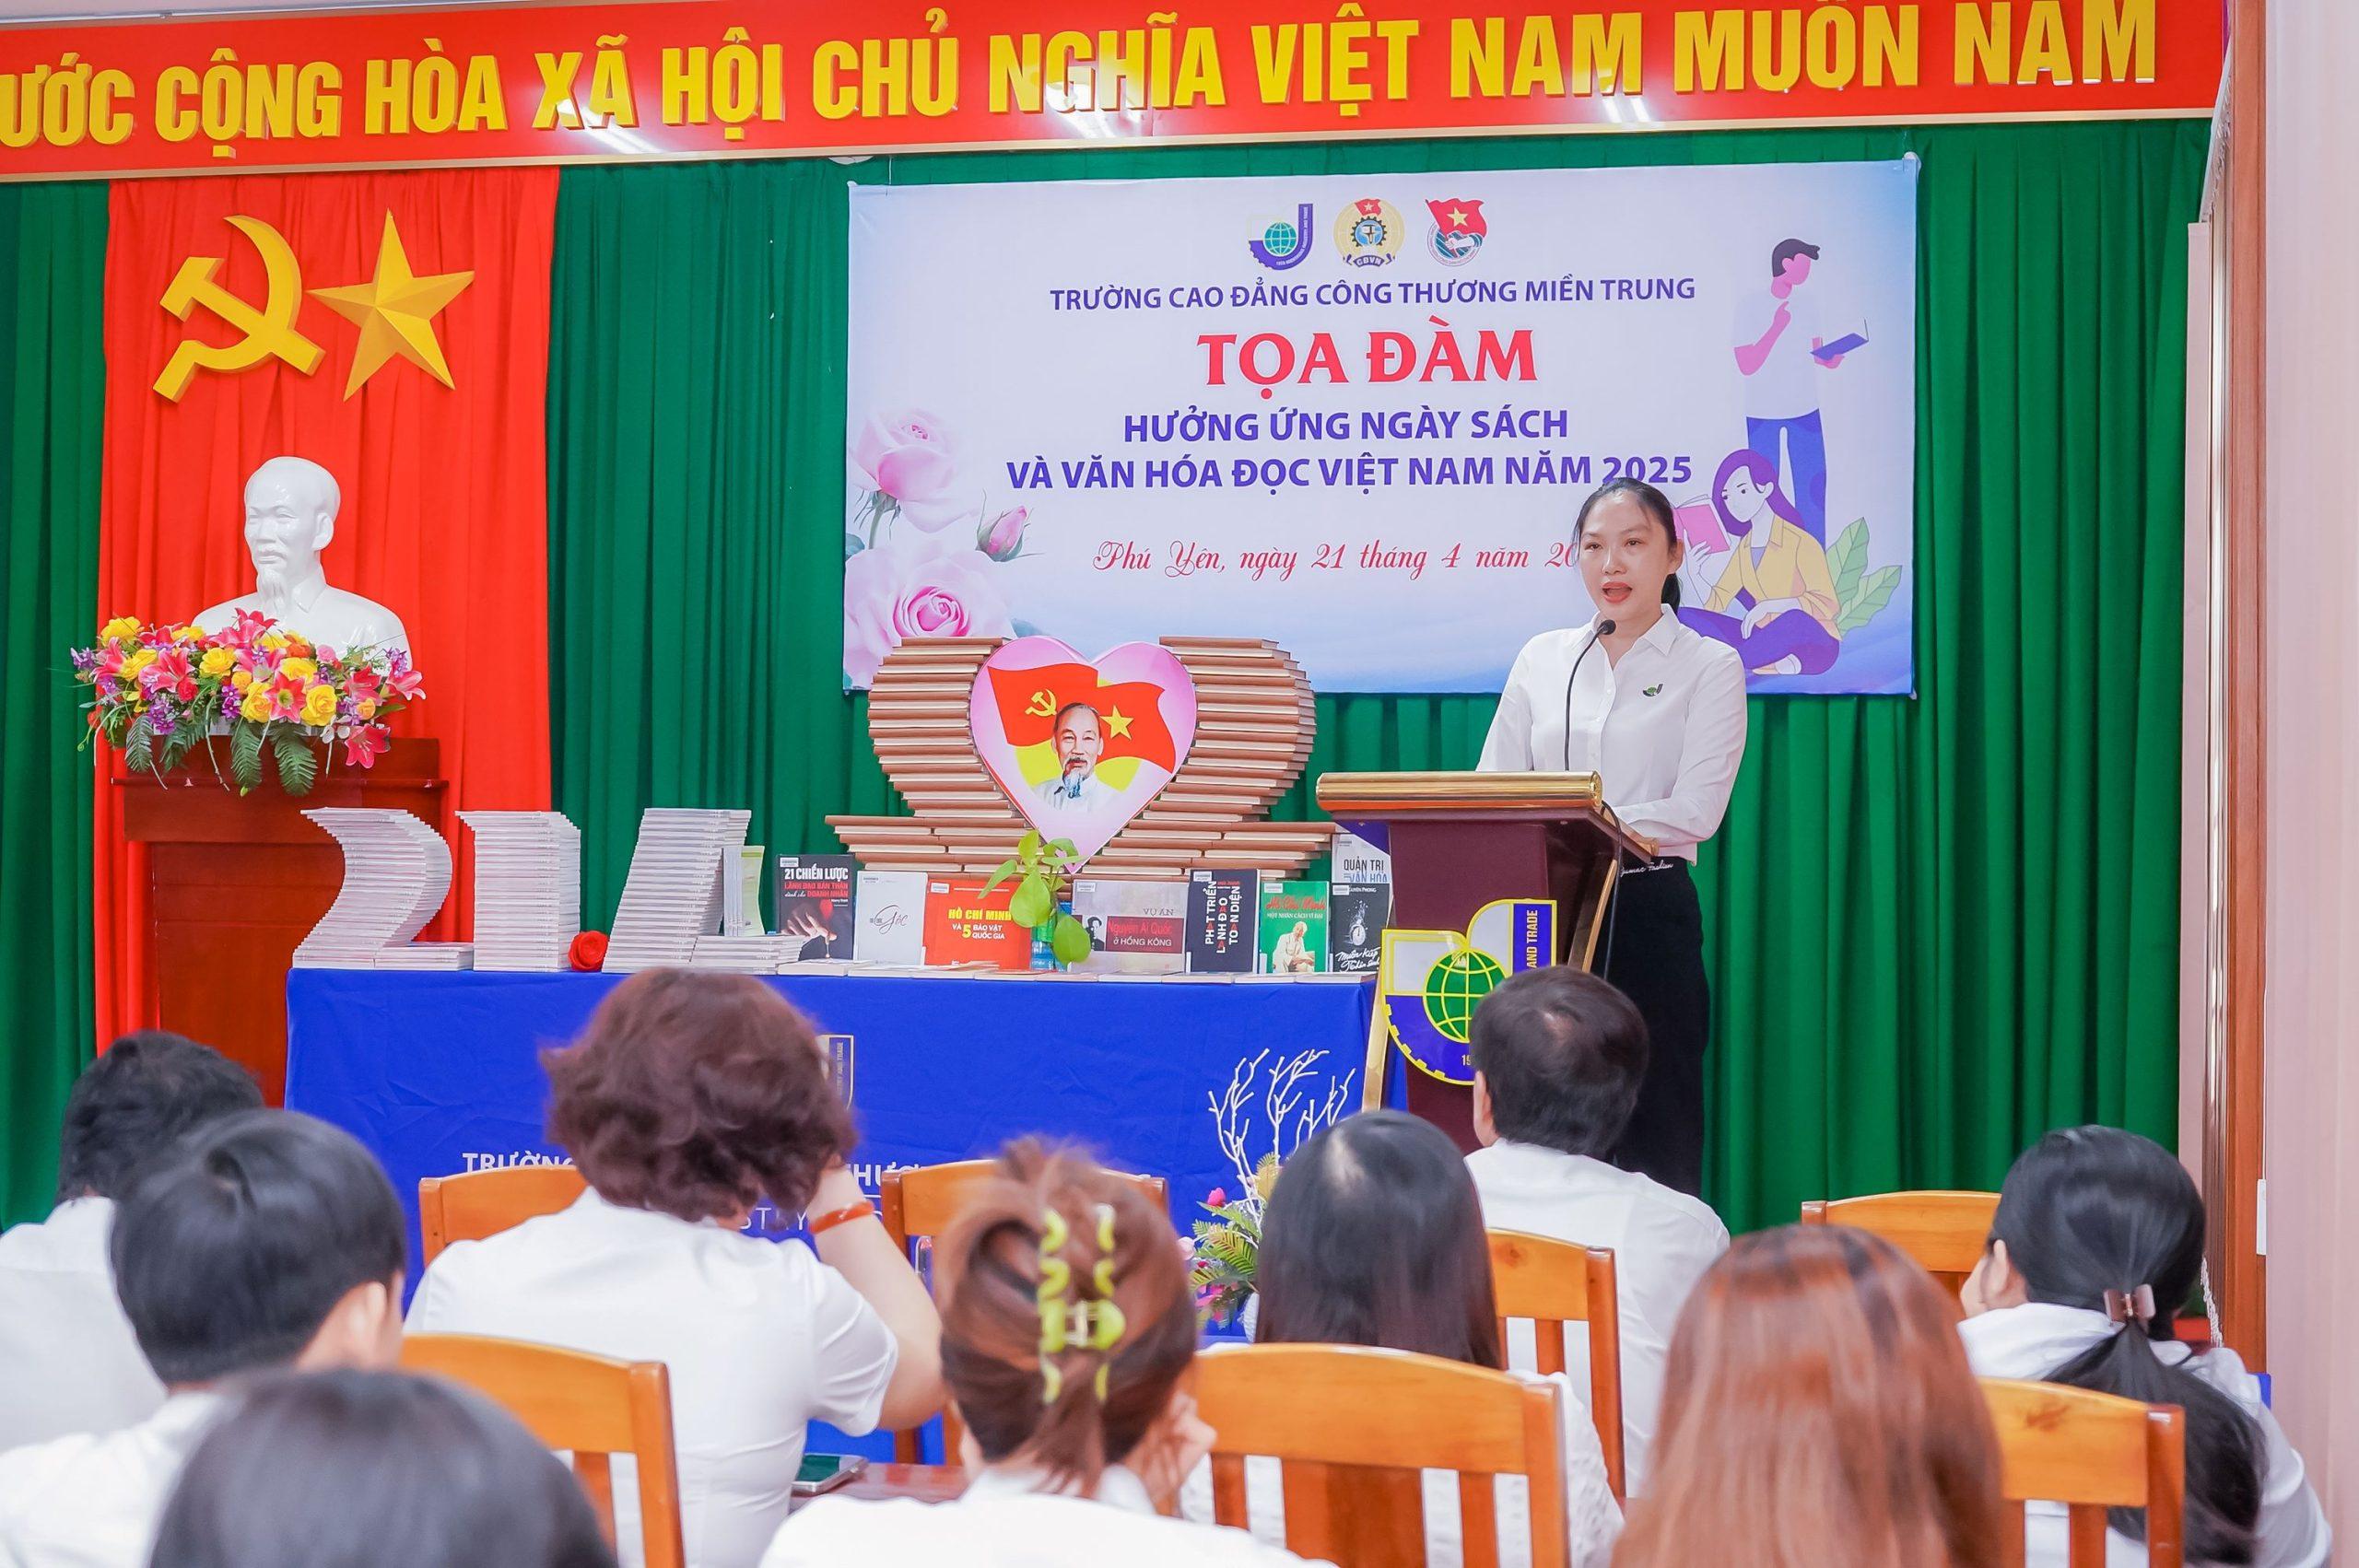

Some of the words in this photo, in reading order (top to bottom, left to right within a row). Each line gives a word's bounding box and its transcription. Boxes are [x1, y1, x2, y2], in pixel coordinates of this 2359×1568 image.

[0, 53, 135, 147] ƯỚC
[155, 48, 342, 158] CỘNG
[366, 39, 506, 135] HÒA
[533, 34, 640, 130] XÃ
[663, 27, 785, 141] HỘI
[813, 7, 958, 120] CHỦ
[989, 12, 1226, 112] NGHĨA
[1251, 3, 1420, 117] VIỆT
[1451, 13, 1644, 99] NAM
[1050, 285, 1162, 311] TRƯỜNG
[1168, 285, 1226, 308] CAO
[1230, 277, 1309, 308] ĐẲNG
[1315, 279, 1392, 305] CÔNG
[1398, 279, 1518, 304] THƯƠNG
[1524, 274, 1595, 302] MIỀN
[1601, 277, 1696, 301] TRUNG
[1197, 333, 1349, 400] TỌA
[1366, 314, 1538, 383] ĐÀM
[1123, 406, 1261, 443] HƯỞNG
[1269, 404, 1351, 441] ỨNG
[1361, 407, 1462, 440] NGÀY
[1471, 406, 1568, 439] SÁCH
[1007, 457, 1052, 490] VÀ
[1062, 451, 1135, 489] VĂN
[1145, 454, 1224, 488] HÓA
[1232, 459, 1310, 496] ĐỌC
[1317, 452, 1398, 496] VIỆT
[1409, 457, 1495, 486] NAM
[1506, 451, 1591, 485] NĂM
[1602, 456, 1692, 484] 2025
[1093, 541, 1151, 570] Phú
[1165, 540, 1226, 578] Yên,
[1240, 546, 1298, 581] ngày
[1310, 544, 1346, 569] 21
[1360, 539, 1428, 580] tháng
[1440, 543, 1461, 568] 4
[1475, 546, 1530, 568] năm
[1544, 542, 1579, 568] 20
[784, 868, 794, 880] 21
[795, 862, 823, 880] CHIẾN
[825, 867, 849, 882] LƯỢC
[1344, 856, 1367, 872] QUẢN
[1370, 860, 1384, 872] TRỊ
[1203, 881, 1216, 914] TRIỂN
[1228, 886, 1242, 913] DIỆN
[948, 906, 962, 919] HỒ
[965, 907, 983, 919] CHÍ
[985, 909, 1012, 921] MINH
[1527, 909, 1538, 943] TRADE
[962, 924, 971, 938] 5
[971, 930, 992, 940] QUỐC
[1147, 937, 1172, 947] KÔNG
[1527, 946, 1538, 968] AND
